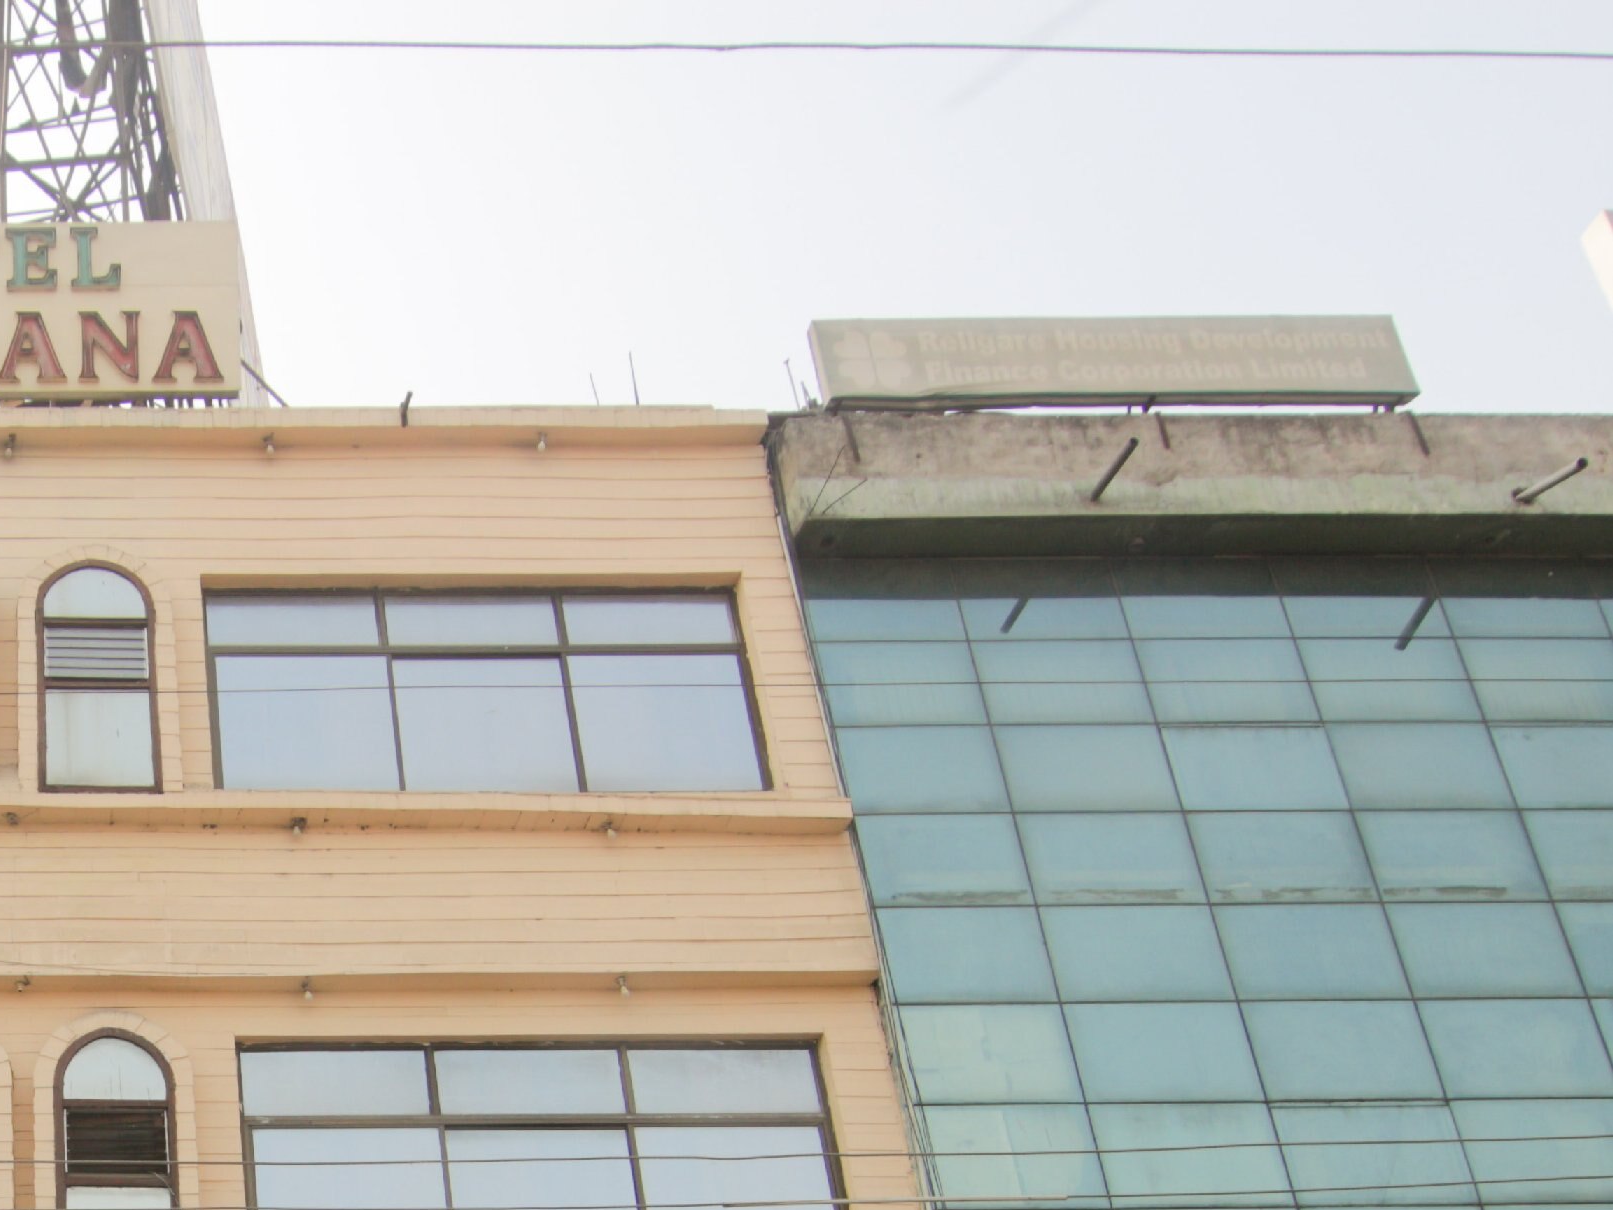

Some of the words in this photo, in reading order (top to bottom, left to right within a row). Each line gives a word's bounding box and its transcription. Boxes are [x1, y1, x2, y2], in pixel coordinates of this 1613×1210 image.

[919, 330, 1047, 355] Religare
[1055, 327, 1183, 355] Housing
[1190, 327, 1389, 353] Development
[924, 361, 1049, 383] Finance
[1057, 359, 1243, 383] Corporation
[1251, 357, 1367, 380] Limited
